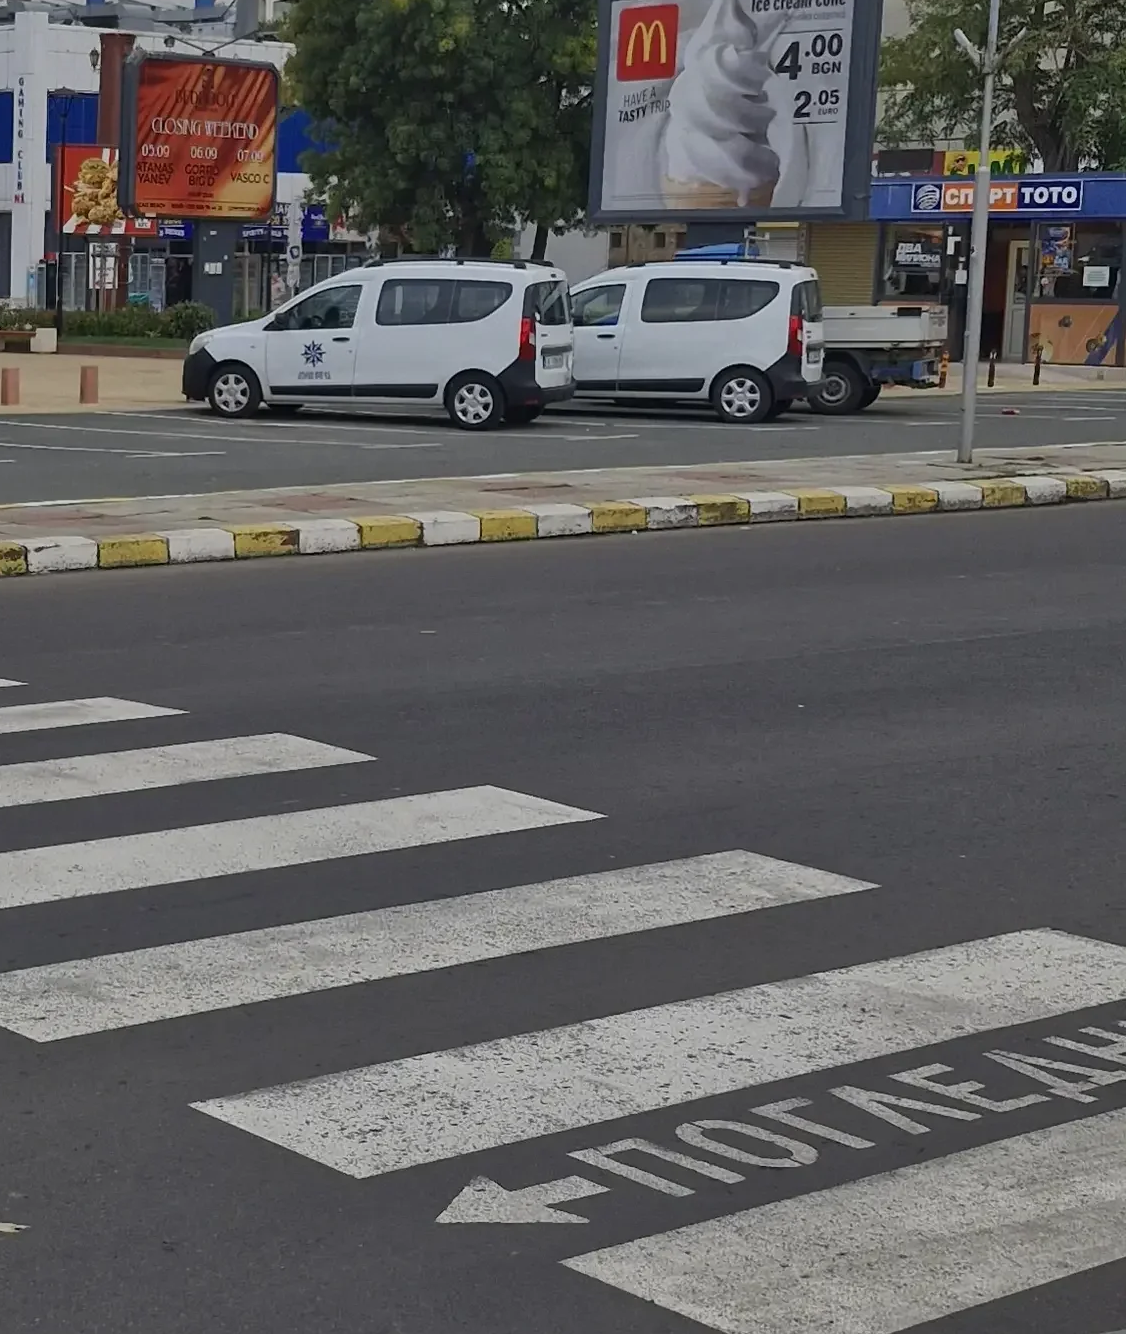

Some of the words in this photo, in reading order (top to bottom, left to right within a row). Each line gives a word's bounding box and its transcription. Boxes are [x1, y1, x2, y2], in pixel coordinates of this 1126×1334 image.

[811, 61, 842, 75] BGN
[623, 88, 648, 107] HAVE
[650, 85, 657, 99] A
[793, 89, 840, 118] 2.05
[618, 104, 647, 123] TASTY
[649, 99, 671, 114] TRIP
[152, 117, 200, 136] CLOSING
[204, 120, 259, 140] WEEKEND
[190, 147, 218, 160] 06.09
[230, 171, 261, 184] VASCO
[262, 173, 270, 184] C
[945, 187, 1016, 205] СПРТ
[1021, 186, 1078, 205] ТОТО
[897, 242, 922, 254] ДВА
[566, 1021, 1126, 1197] ПОГЛЕДН
